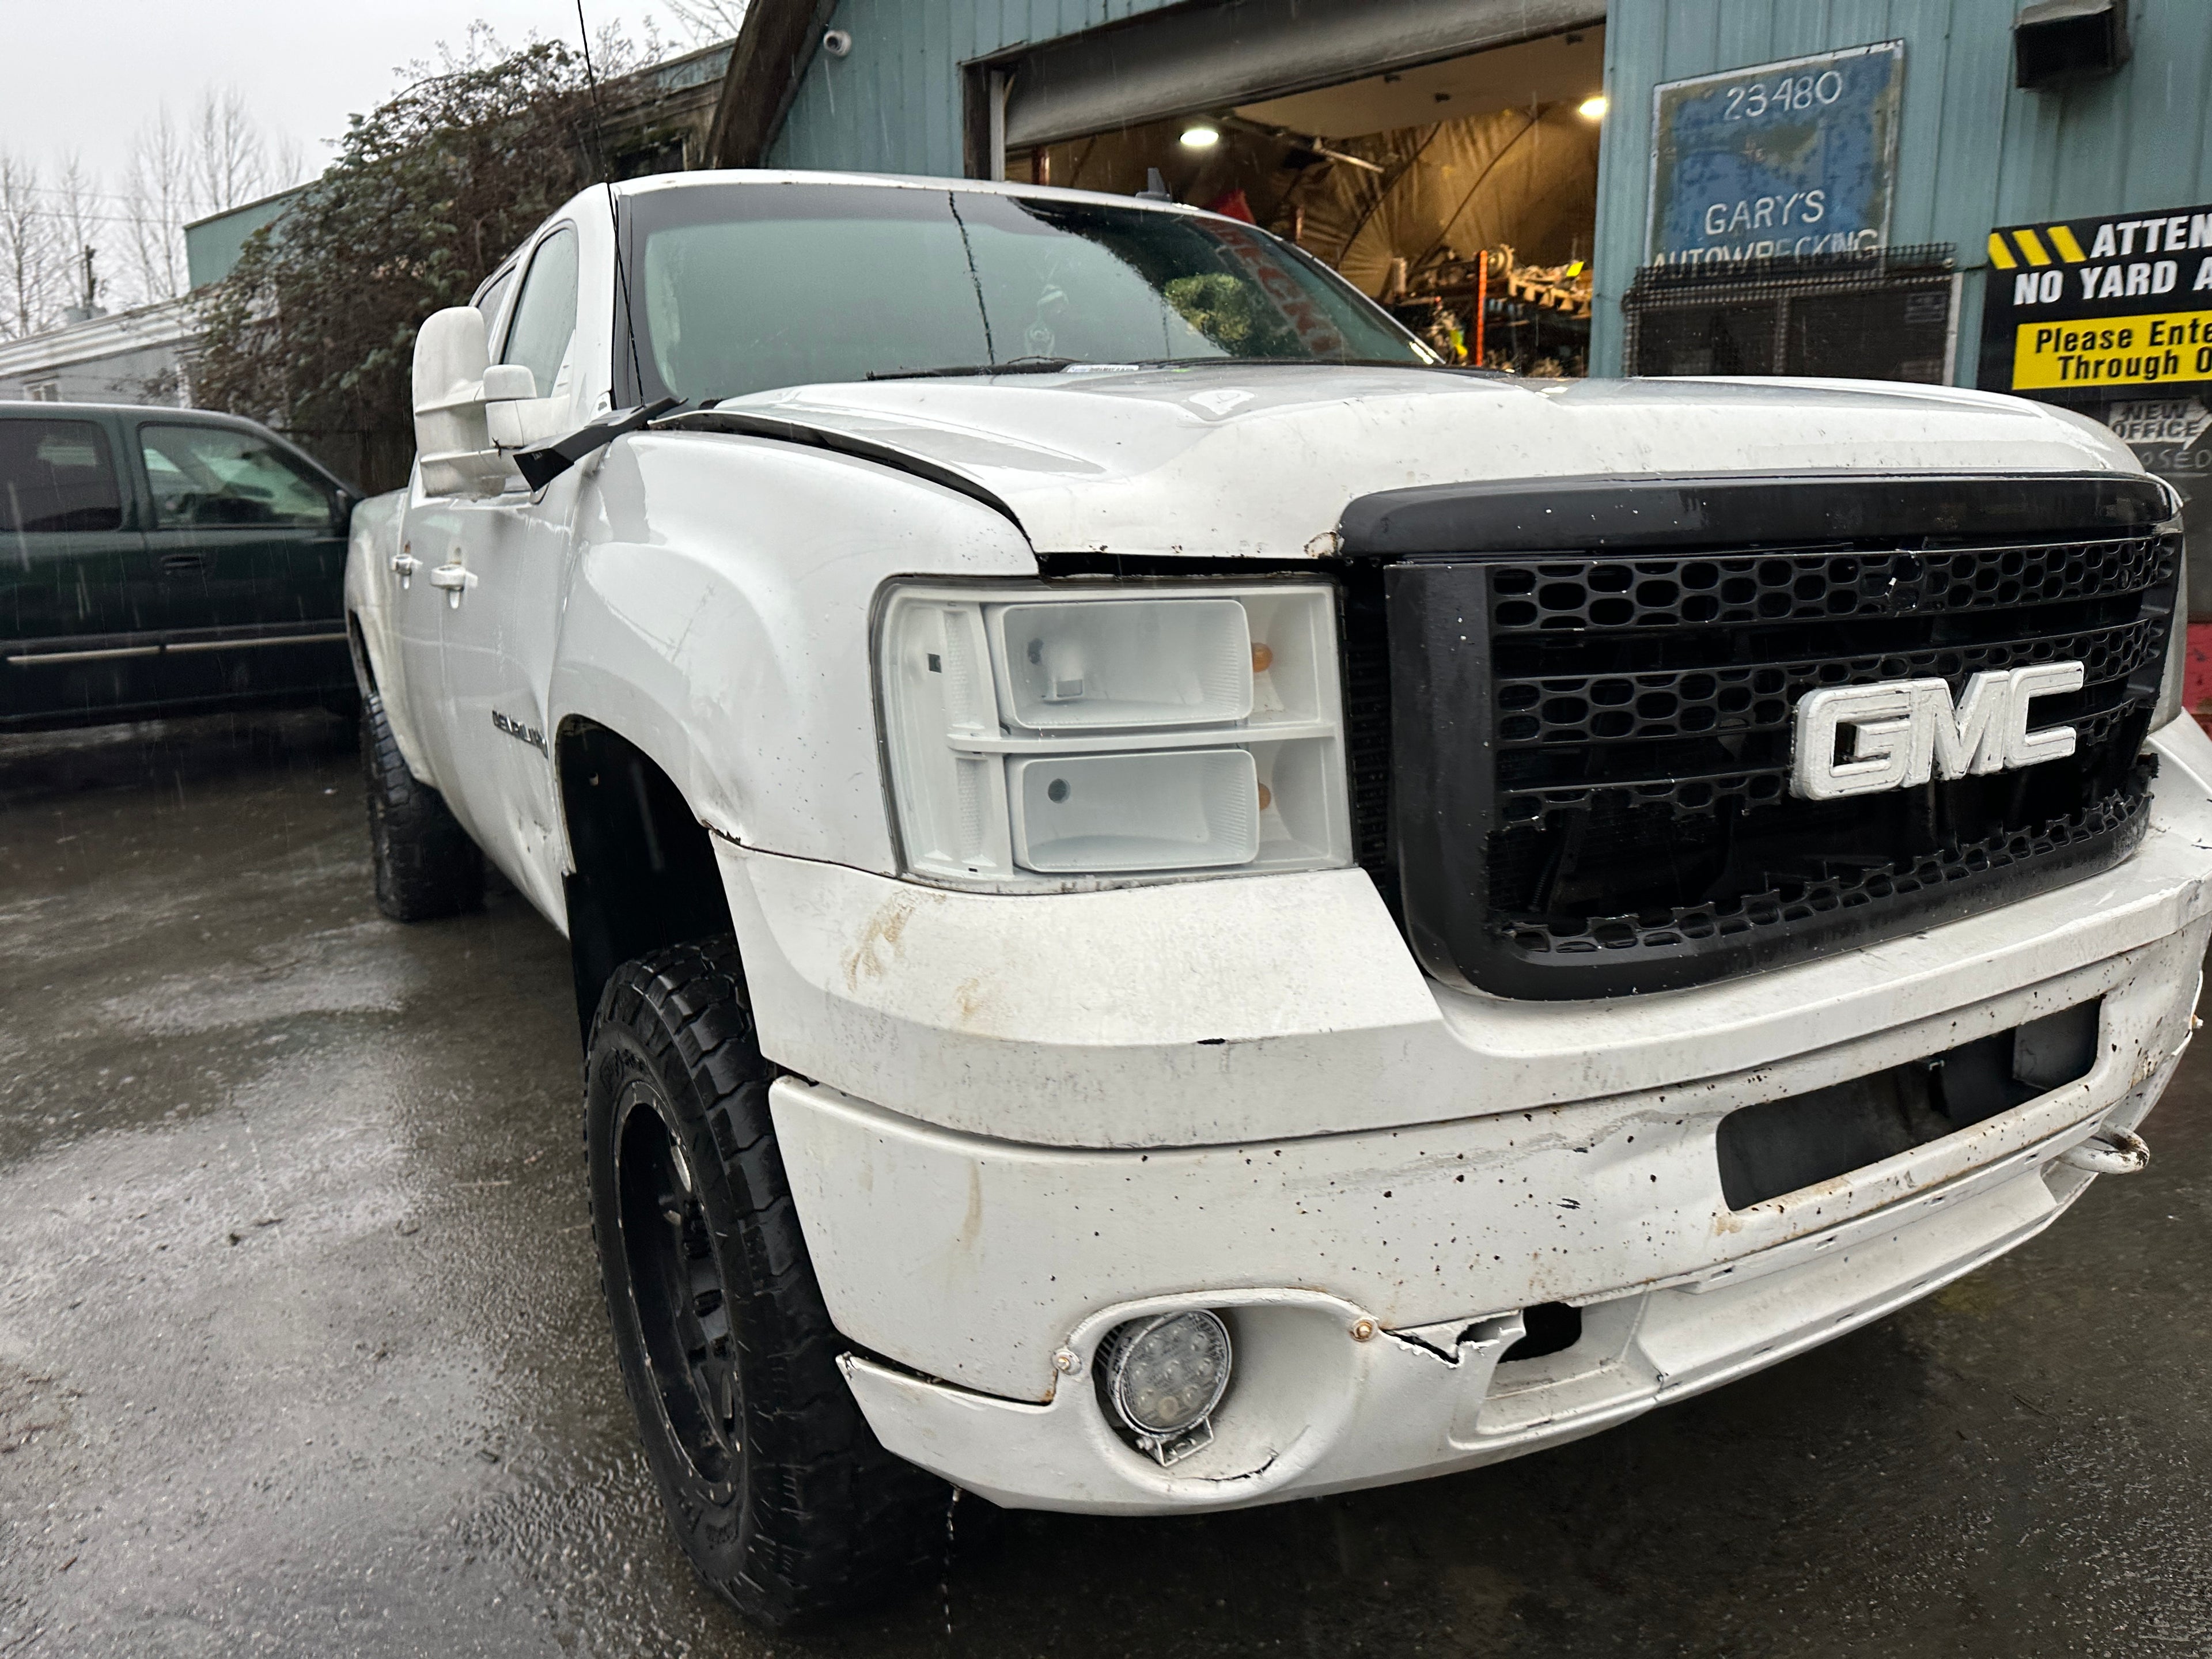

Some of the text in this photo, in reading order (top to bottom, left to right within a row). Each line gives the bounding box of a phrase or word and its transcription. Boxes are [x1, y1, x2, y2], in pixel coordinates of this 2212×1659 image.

[1724, 70, 1842, 120] 23480
[1705, 190, 1825, 236] GARY'S
[2014, 270, 2064, 305] NO
[2080, 260, 2178, 300] YARD
[2036, 328, 2133, 353] Please
[2058, 350, 2178, 380] Through
[2112, 421, 2201, 439] OFFICE
[1789, 661, 2084, 801] GMC
